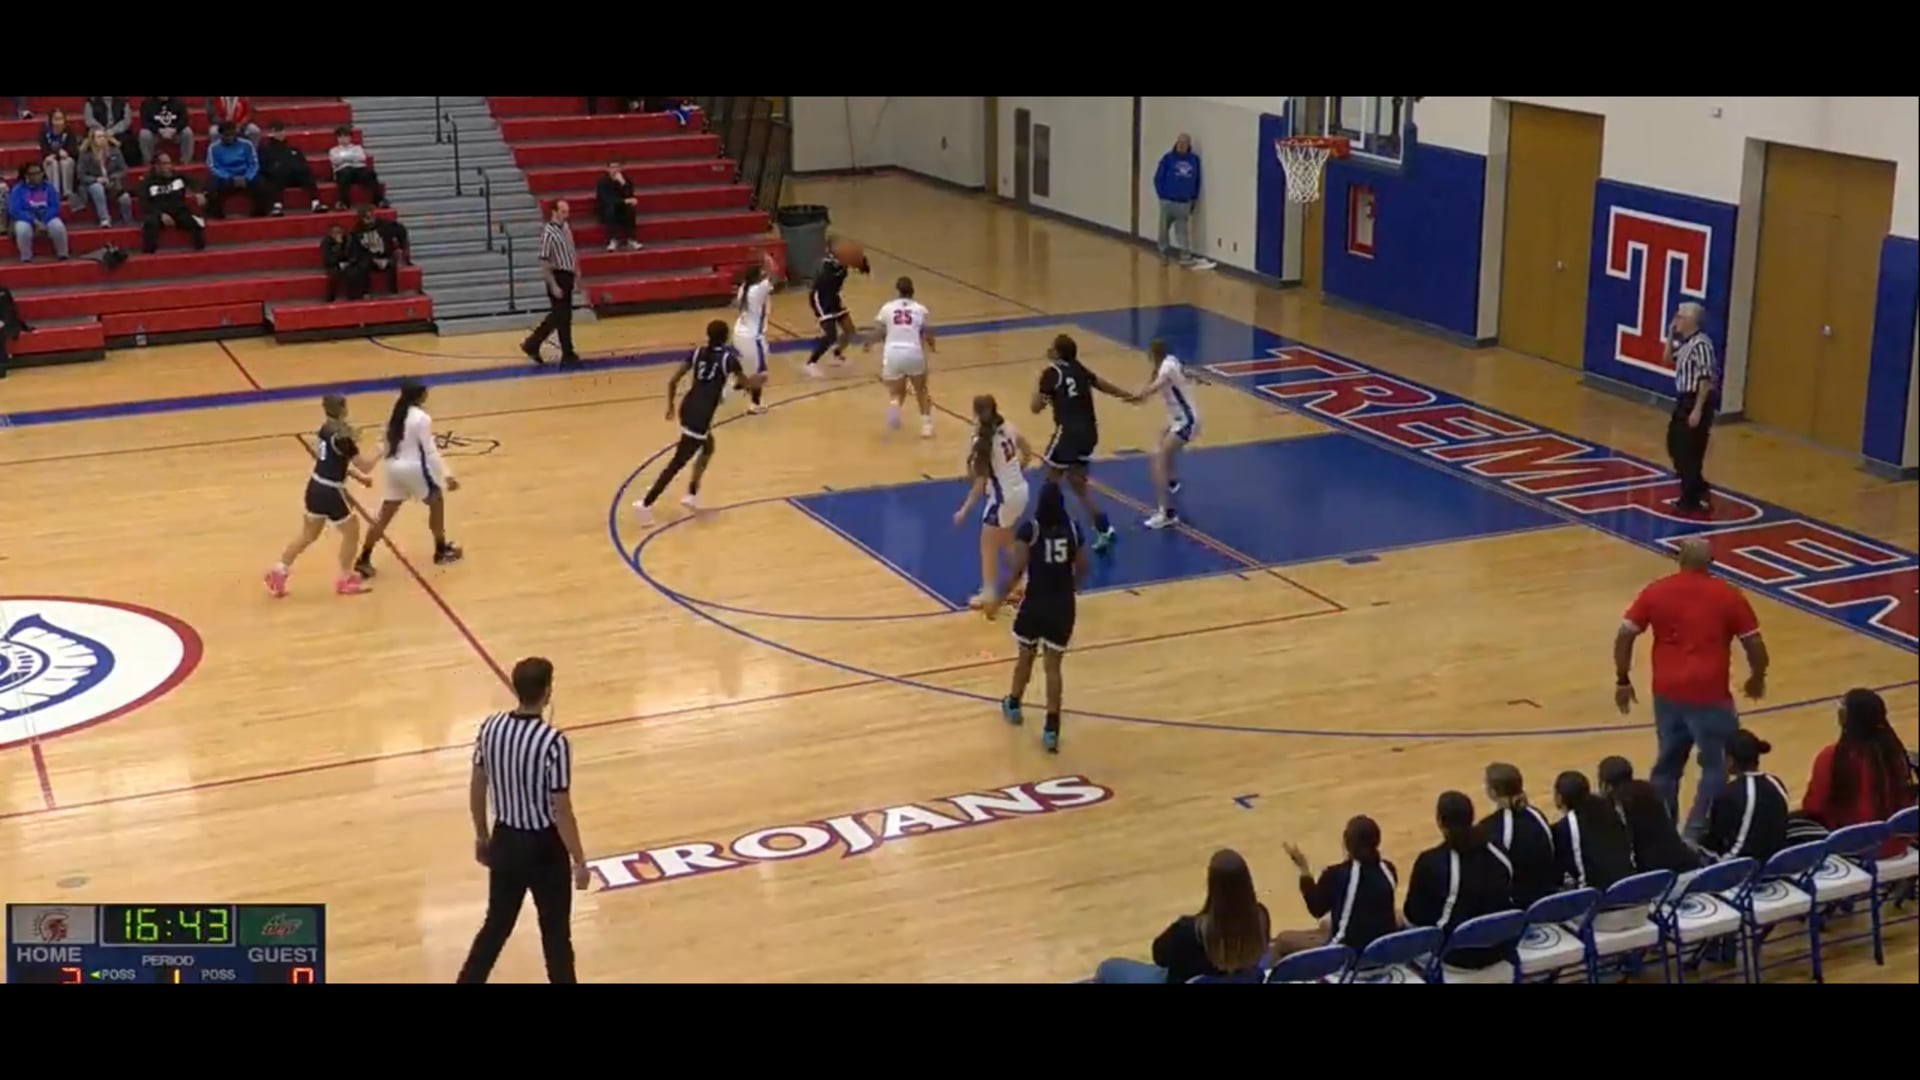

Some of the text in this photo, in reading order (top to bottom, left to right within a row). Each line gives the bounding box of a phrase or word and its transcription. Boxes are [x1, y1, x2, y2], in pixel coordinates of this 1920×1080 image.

[1606, 205, 1712, 377] T
[893, 309, 913, 326] 25
[1065, 377, 1079, 397] 2
[1044, 537, 1069, 563] 15
[584, 774, 1115, 891] TROJANS
